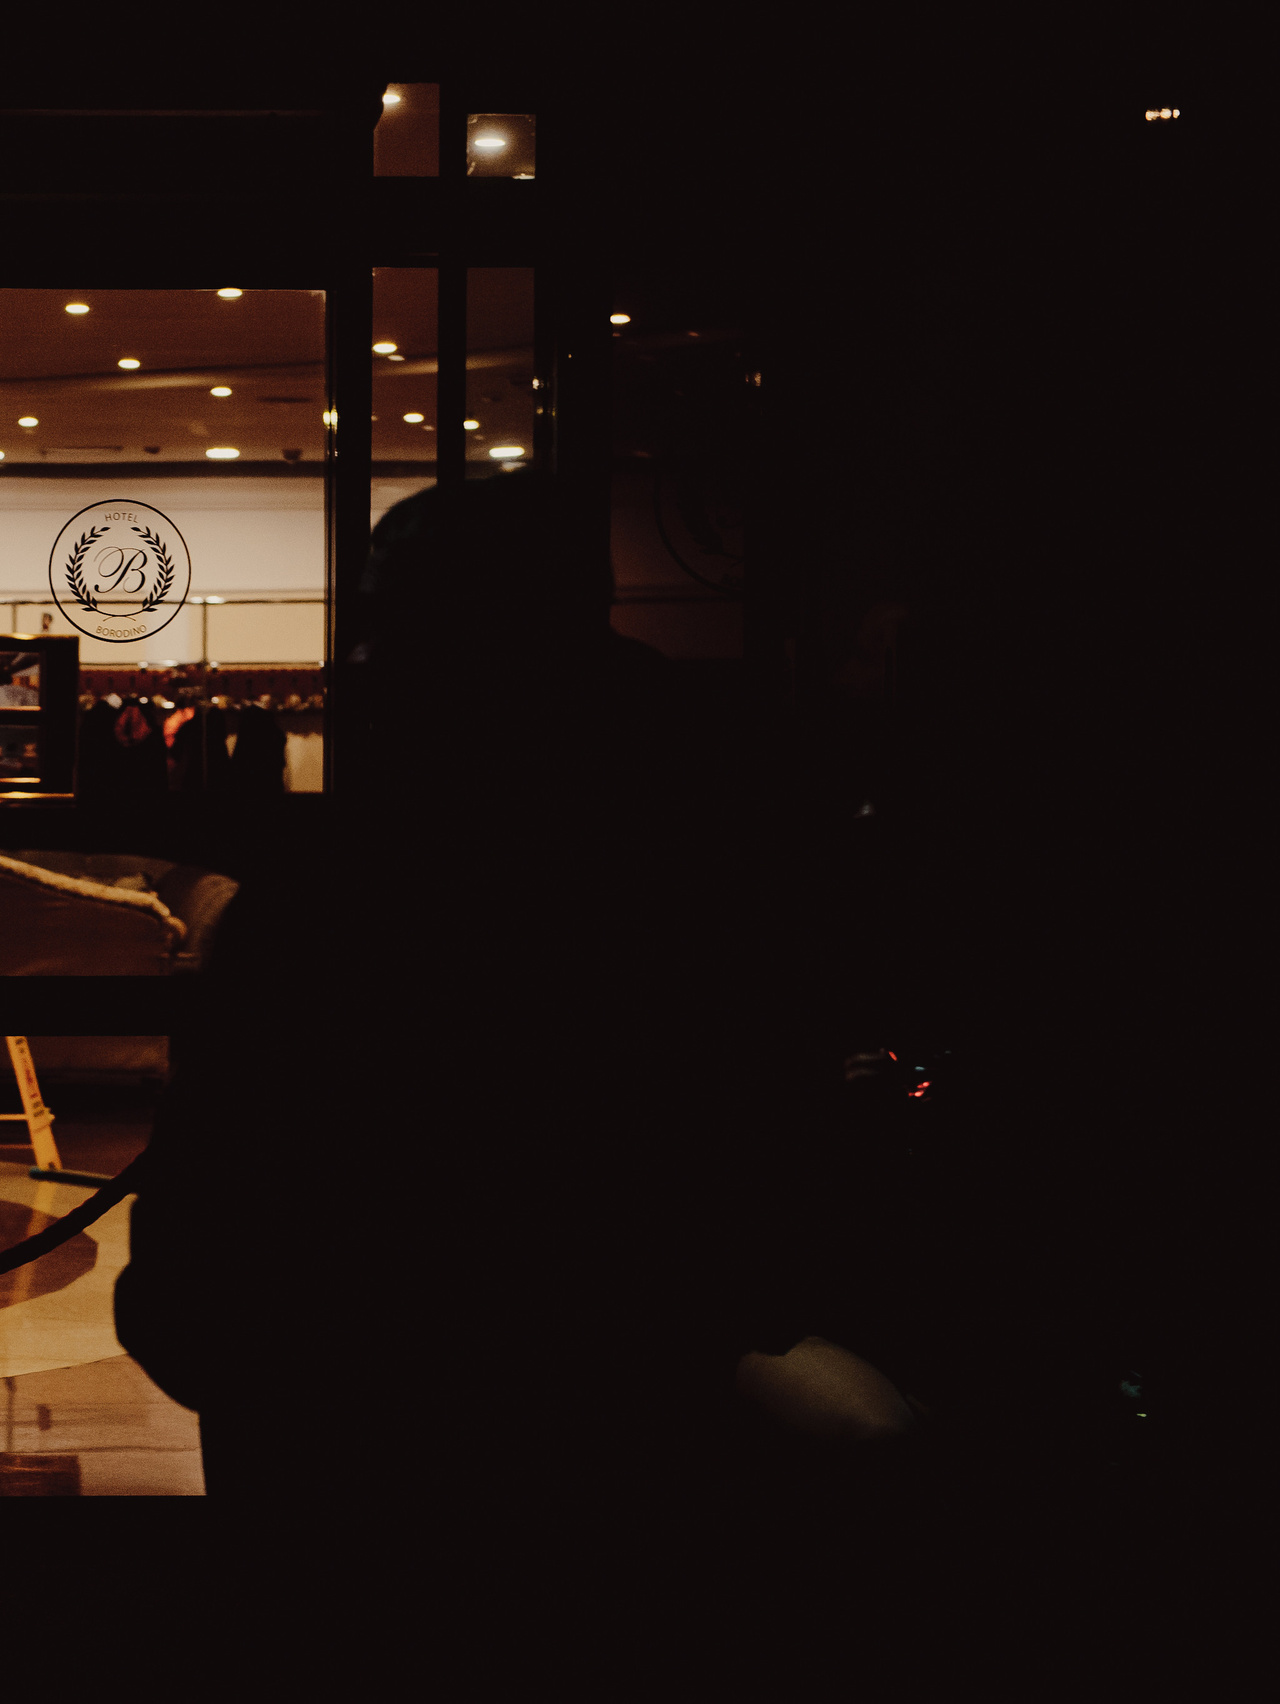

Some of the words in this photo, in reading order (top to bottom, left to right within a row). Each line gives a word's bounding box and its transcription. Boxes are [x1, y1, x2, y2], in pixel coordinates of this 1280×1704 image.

[104, 512, 139, 524] HOTEL
[93, 546, 148, 594] B
[95, 624, 147, 638] BORODINO
